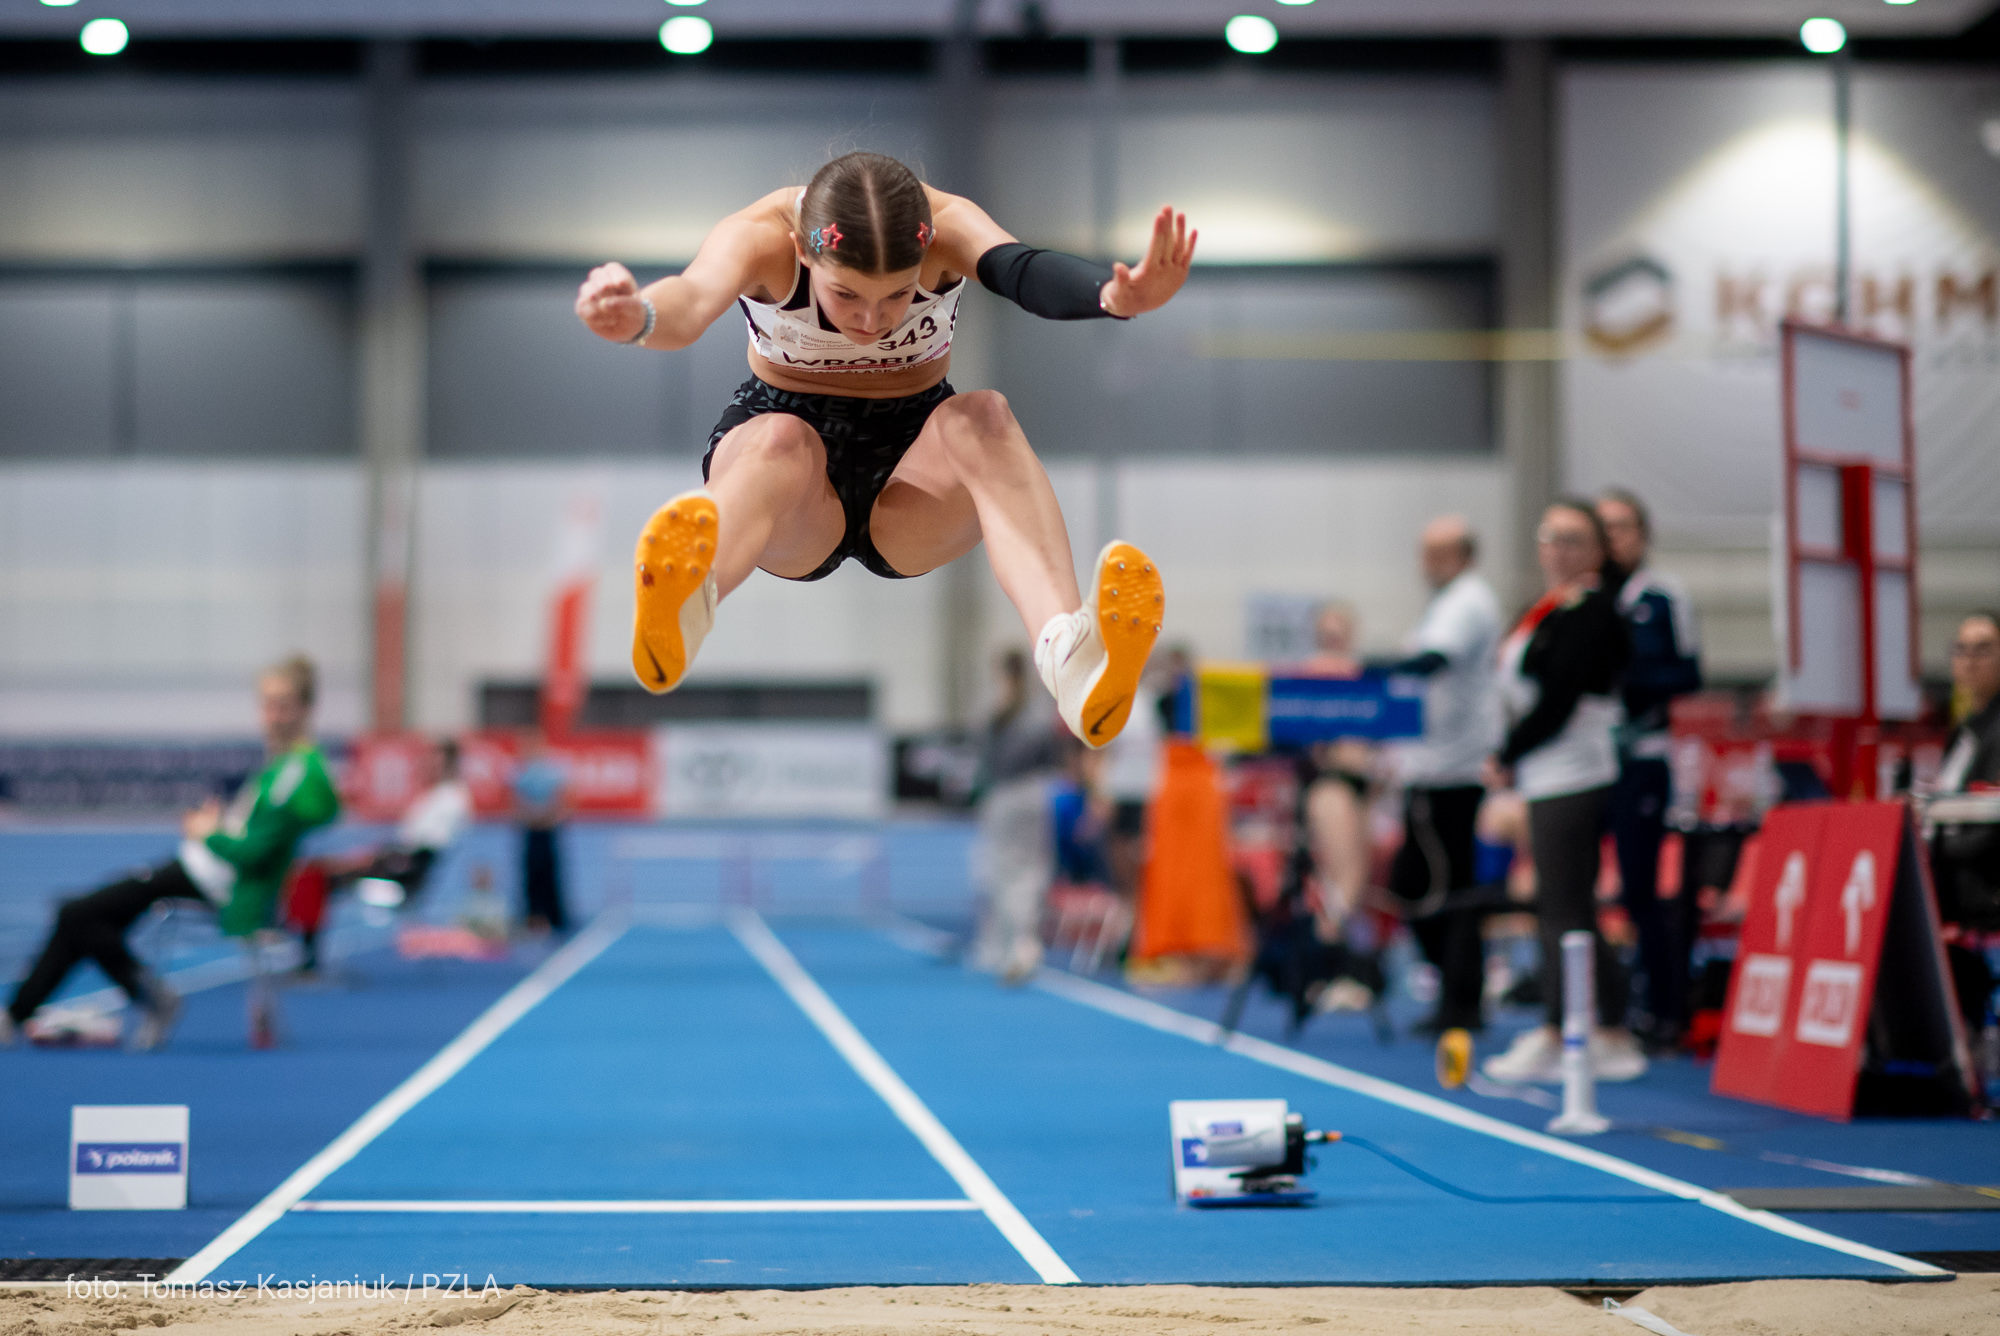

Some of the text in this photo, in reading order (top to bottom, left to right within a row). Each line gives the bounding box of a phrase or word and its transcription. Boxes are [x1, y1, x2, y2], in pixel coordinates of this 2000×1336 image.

[800, 333, 843, 344] Ministerstwo
[800, 339, 821, 348] Sportu
[877, 315, 938, 351] 343
[755, 379, 853, 415] NIKE
[104, 1148, 176, 1169] polanik
